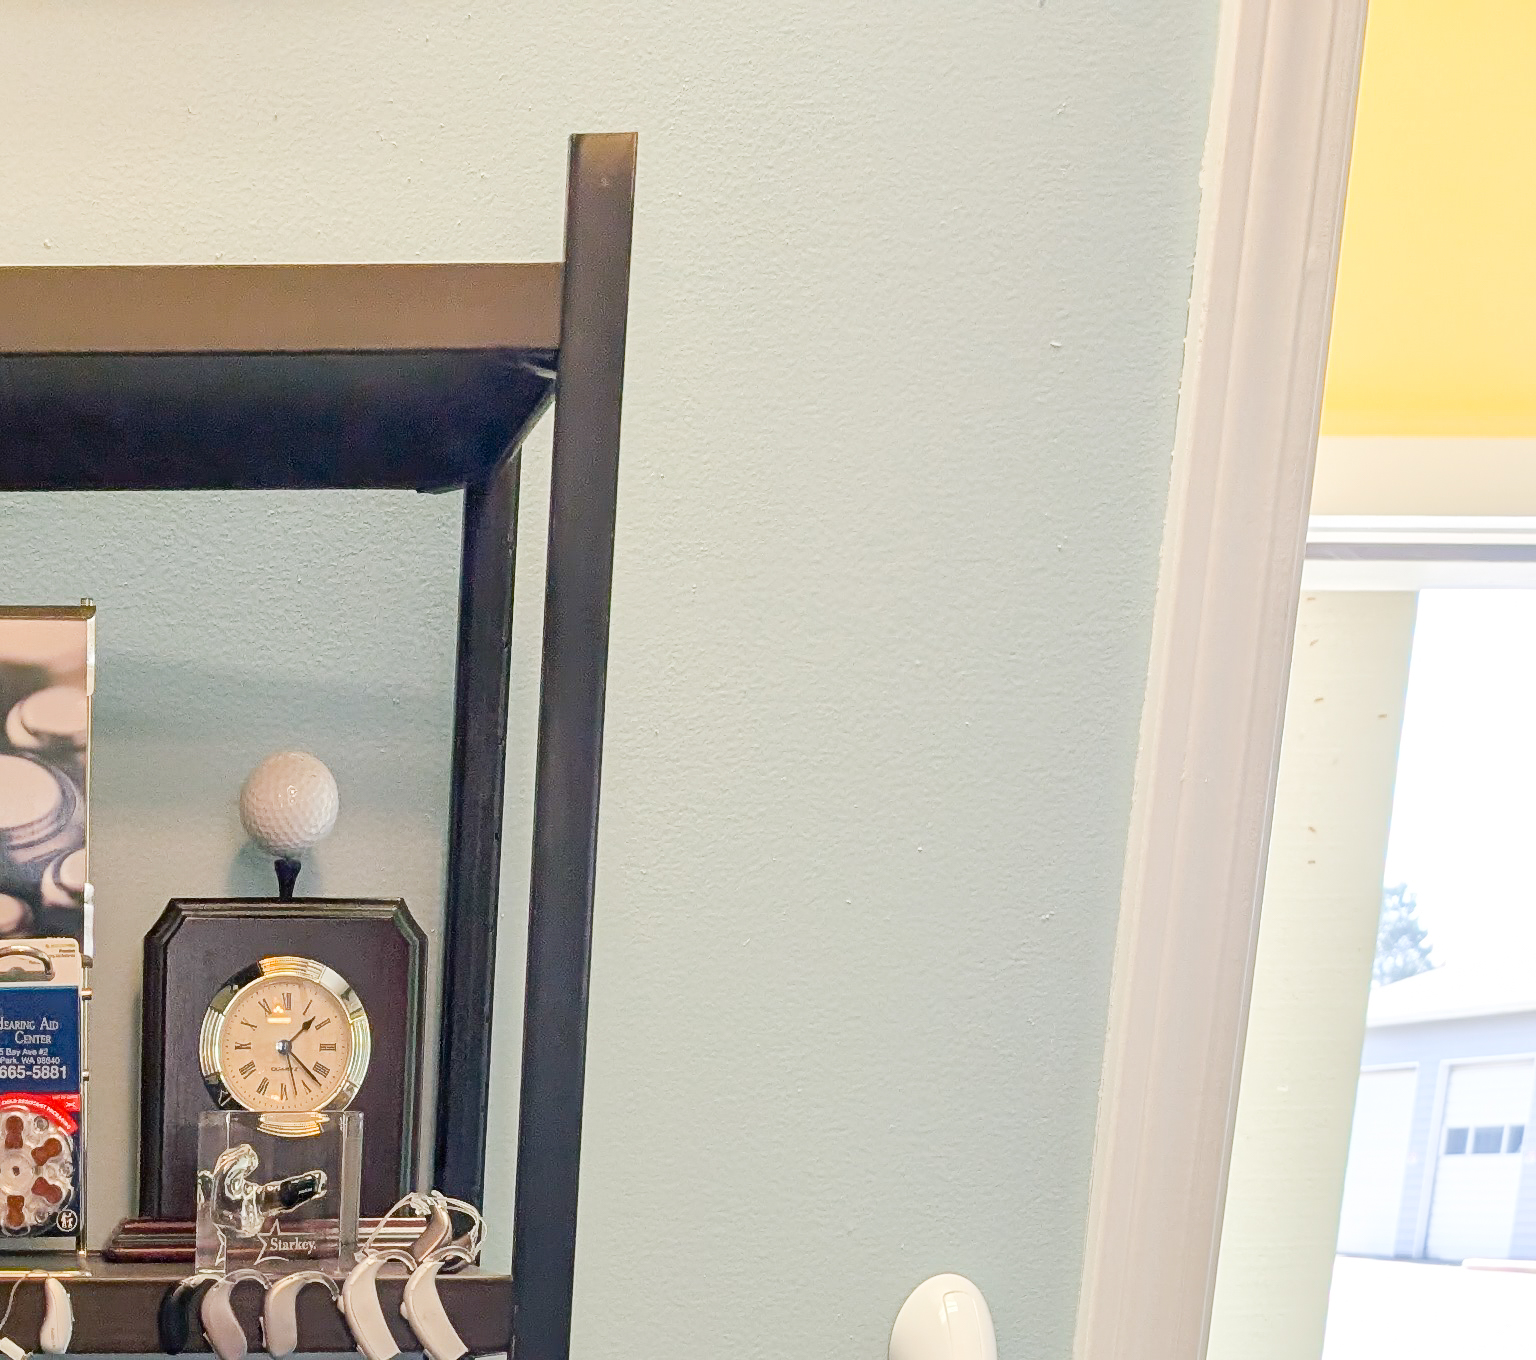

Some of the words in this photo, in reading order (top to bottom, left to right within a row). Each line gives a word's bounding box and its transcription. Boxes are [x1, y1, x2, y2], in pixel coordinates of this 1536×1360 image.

[39, 1016, 59, 1031] AID
[14, 1031, 52, 1045] CENTER
[270, 1237, 316, 1251] Starkey
